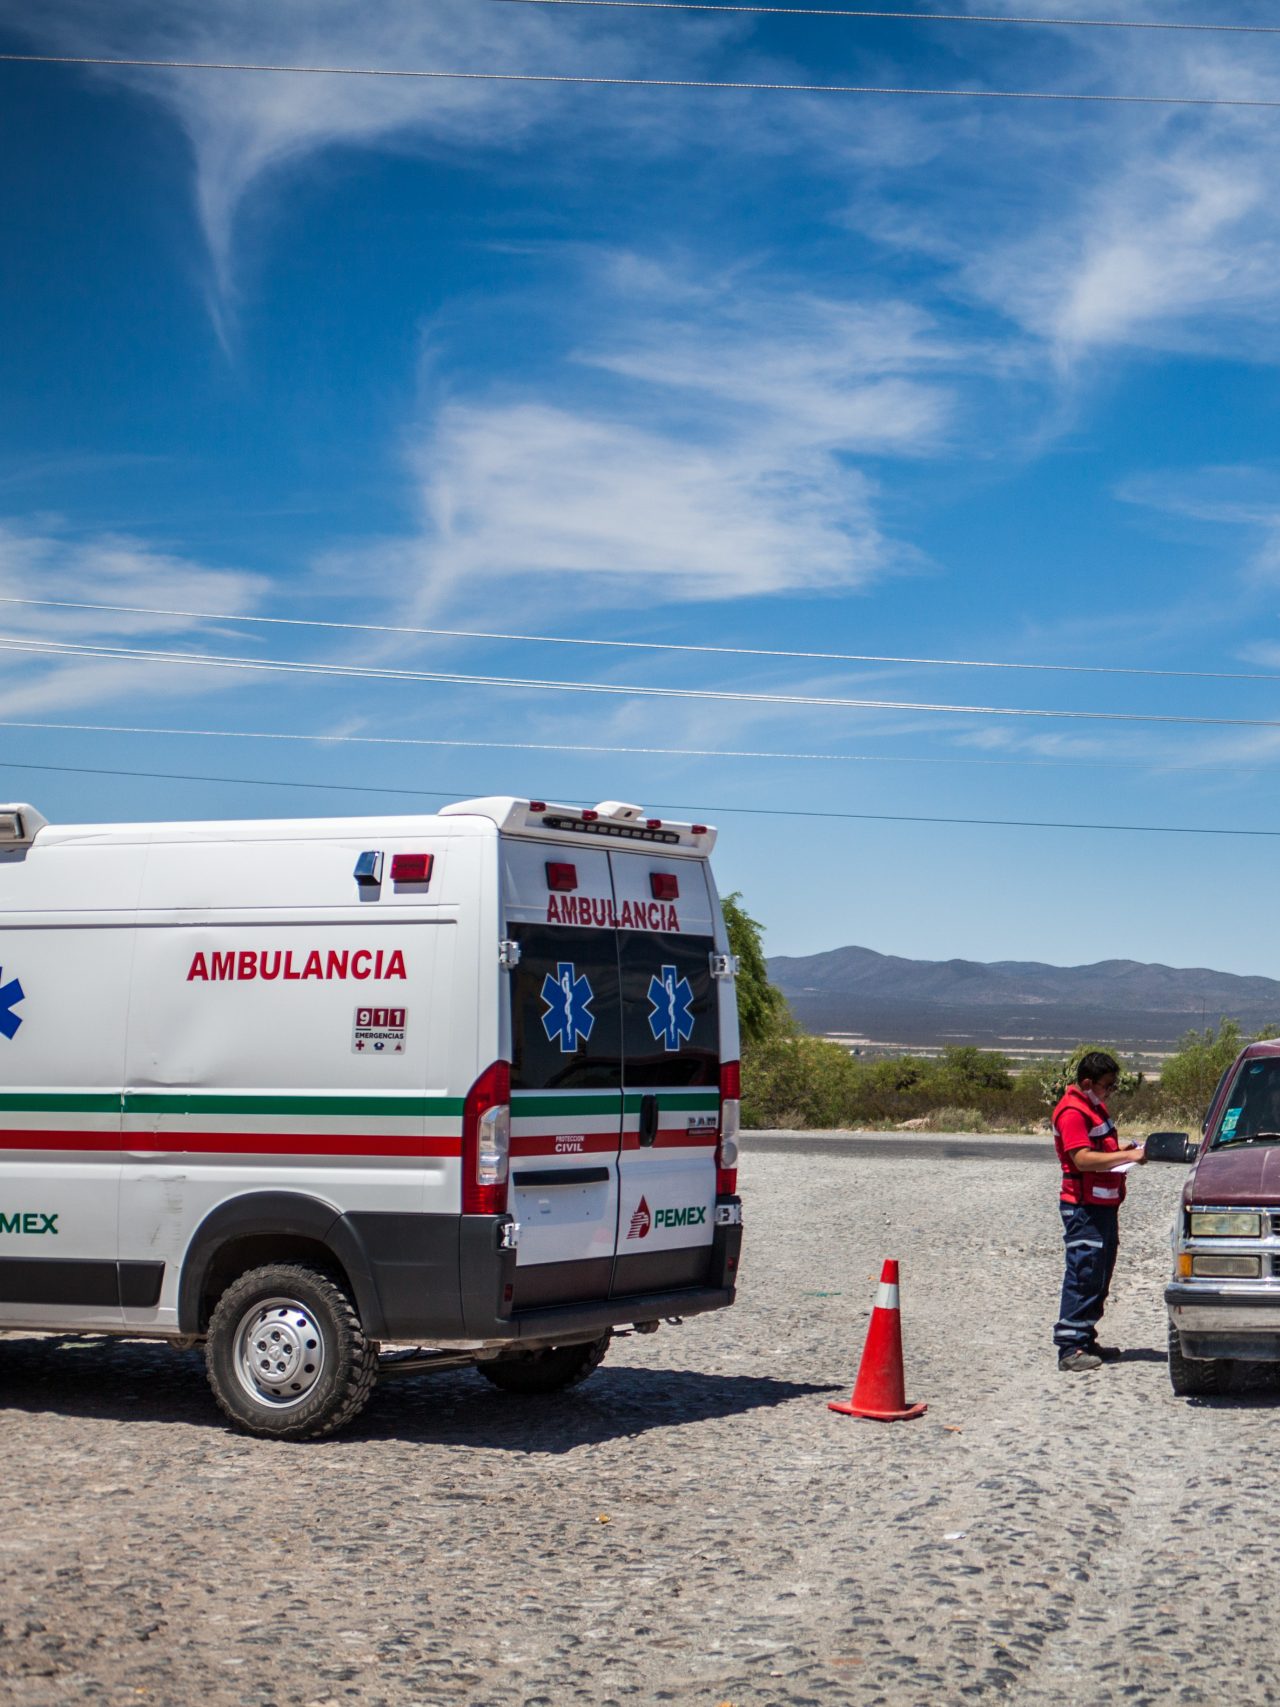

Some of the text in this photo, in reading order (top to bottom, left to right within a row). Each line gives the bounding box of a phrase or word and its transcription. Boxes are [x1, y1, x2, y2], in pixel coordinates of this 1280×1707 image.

[546, 894, 680, 932] AMBULANCIA
[186, 950, 407, 981] AMBULANCIA
[358, 1009, 403, 1026] 911
[355, 1032, 404, 1040] EMERGENCIAS
[555, 1143, 584, 1153] CIVIL
[654, 1206, 706, 1229] PEMEX
